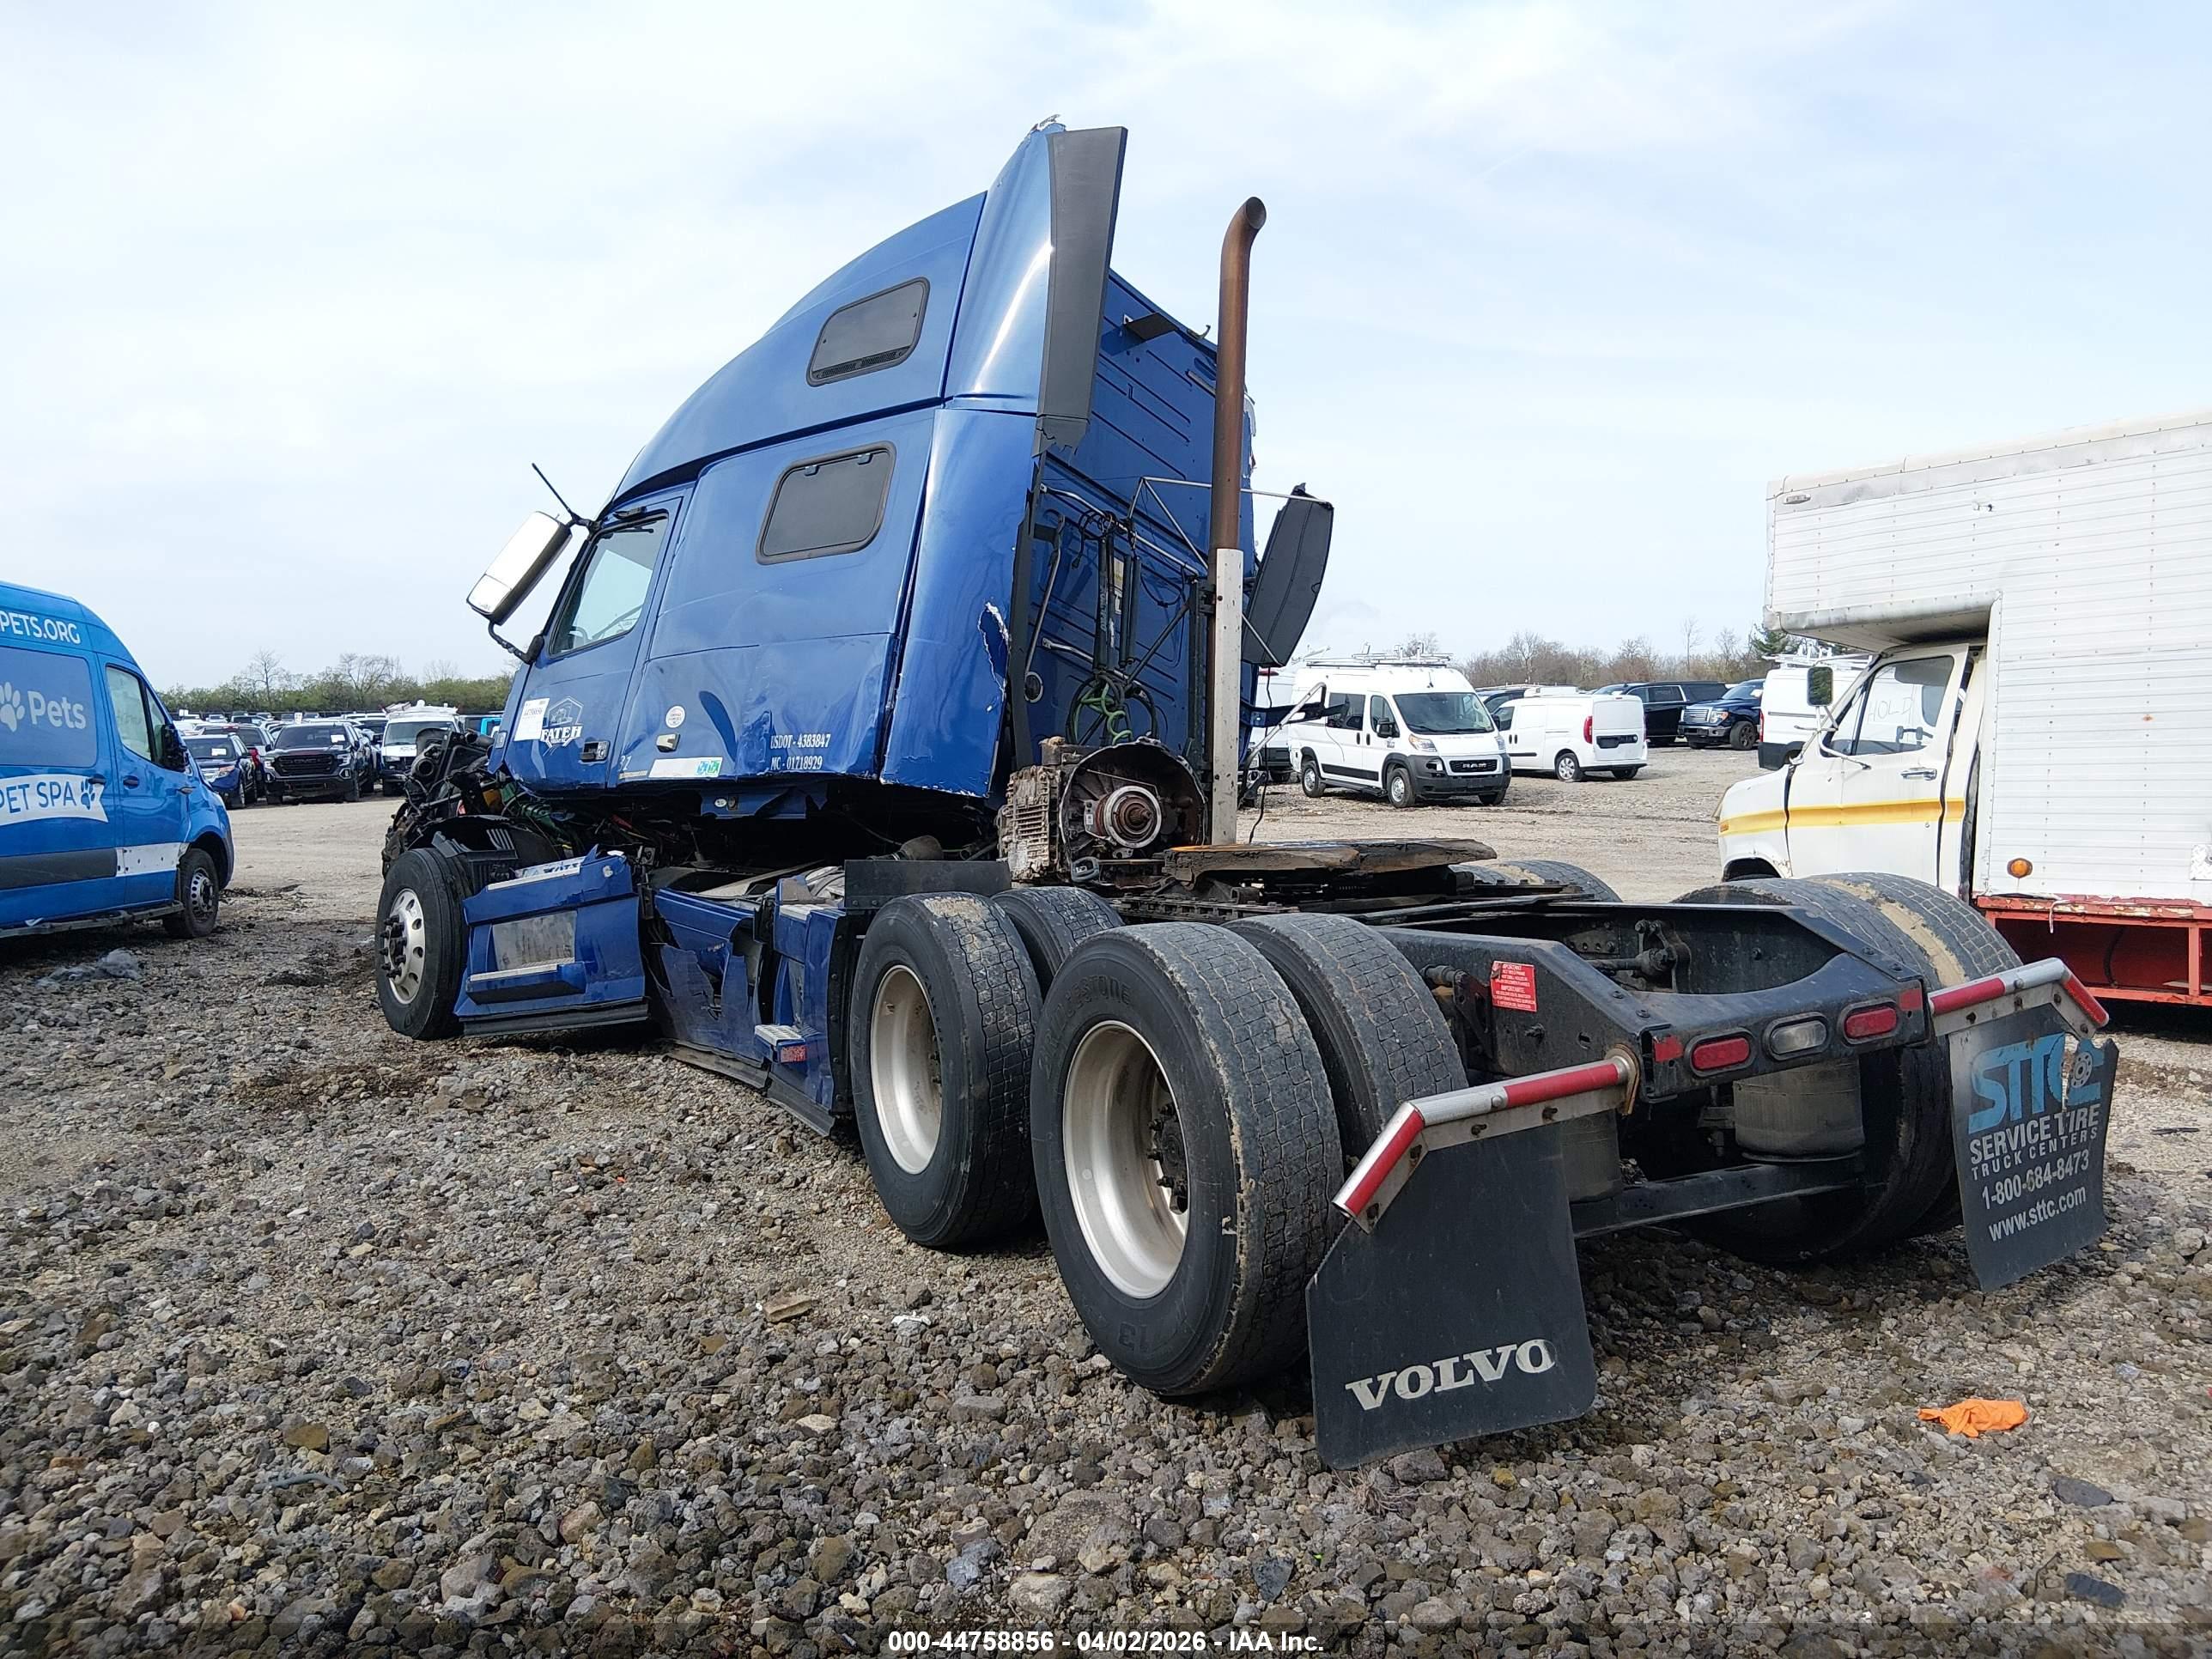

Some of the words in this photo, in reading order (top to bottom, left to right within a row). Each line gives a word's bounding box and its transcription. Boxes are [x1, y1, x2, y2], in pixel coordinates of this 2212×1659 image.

[27, 690, 86, 729] Pets
[770, 734, 793, 749] USDOT
[797, 733, 831, 749] 4383847
[771, 757, 781, 770] MC
[786, 755, 823, 770] 01718929
[36, 781, 77, 808] SPA
[1970, 1115, 2051, 1164] SERVICE
[2054, 1104, 2101, 1136] TIRE
[1971, 1150, 2022, 1181] TRUCK
[2029, 1127, 2098, 1159] CENTERS
[1982, 1149, 2090, 1210] 1-800-684-8473
[1988, 1187, 2087, 1242] www.sttc.com
[1345, 1339, 1556, 1411] VOLVO
